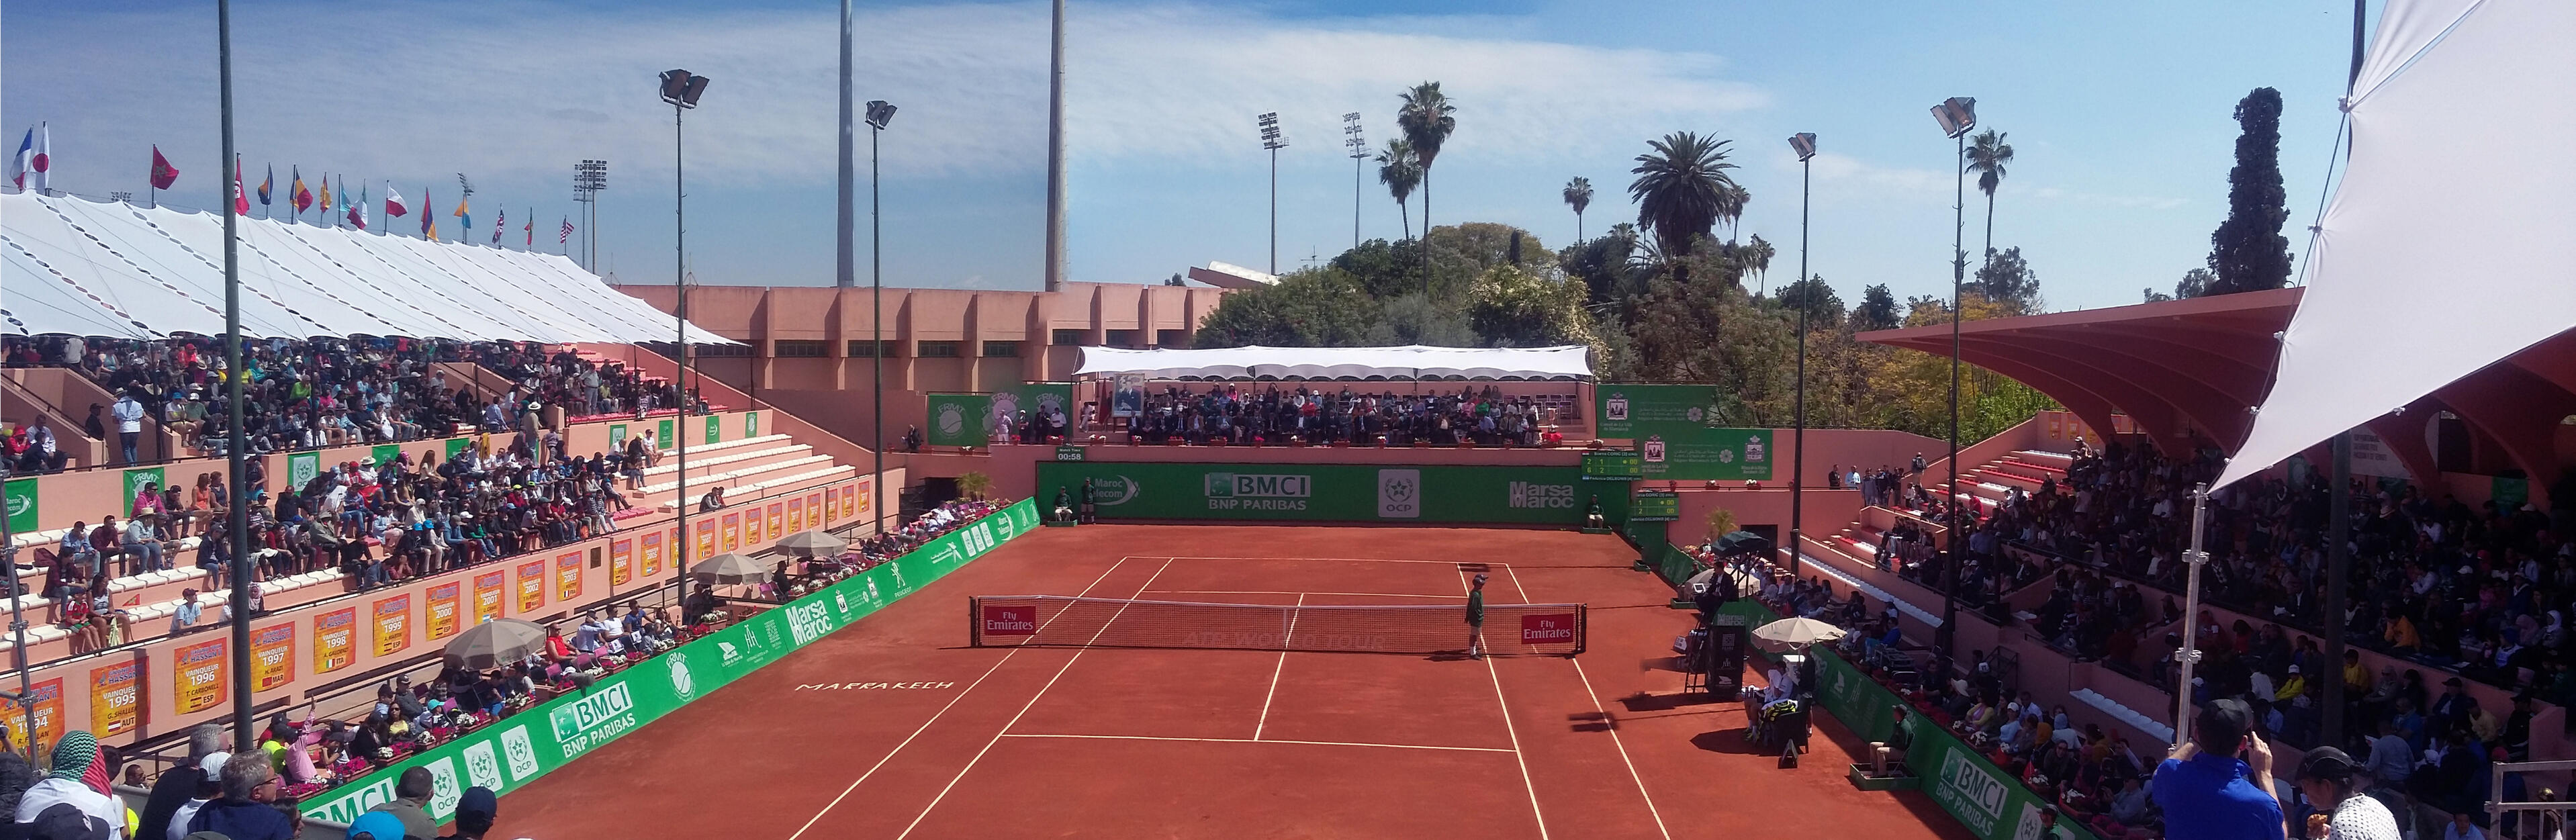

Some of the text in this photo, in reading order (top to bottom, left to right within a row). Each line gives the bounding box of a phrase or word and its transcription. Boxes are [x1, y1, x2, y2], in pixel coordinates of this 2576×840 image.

[991, 392, 1020, 403] FRMT
[1036, 393, 1065, 403] FRMT
[937, 403, 966, 414] FRMT
[133, 472, 160, 484] FRMT
[1095, 479, 1122, 487] Maroc
[1238, 477, 1306, 495] BMCI
[1510, 482, 1573, 496] Marsa
[1096, 489, 1122, 497] lecom
[1209, 500, 1306, 510] BNP PARIBAS
[1510, 494, 1574, 508] Maroc
[615, 559, 627, 568] 2004
[564, 573, 576, 583] 2003
[525, 584, 539, 594] 2002
[894, 586, 912, 598] PEUGEOT
[483, 596, 498, 605] 2001
[436, 608, 452, 618] 2000
[785, 599, 828, 627] Marsa
[1003, 612, 1016, 620] Fly
[384, 621, 402, 633] 1999
[790, 614, 833, 646] Maroc
[987, 620, 1033, 630] Emirates
[1540, 620, 1554, 628] Fly
[263, 635, 286, 644] HASSAN
[322, 629, 349, 641] VAINQUEUR
[1524, 628, 1571, 639] Emirates
[327, 637, 346, 649] 1998
[191, 652, 217, 663] HASSAN
[258, 645, 288, 658] VAINQUEUR
[263, 653, 284, 667] 1997
[666, 652, 687, 669] FRMT
[185, 663, 219, 678] VAINQUEUR
[270, 665, 283, 673] ARAZI
[109, 671, 138, 684] HASSAN
[191, 671, 215, 686] 1996
[273, 674, 283, 683] MAR
[103, 684, 140, 700] VAINQUEUR
[191, 684, 219, 696] CARBONELL
[794, 682, 954, 691] MARRAKECH
[109, 692, 136, 709] 1995
[203, 694, 214, 704] ESP
[114, 706, 138, 718] SHALLER
[580, 684, 630, 729] BMCI
[11, 707, 53, 723] VAINUEUR
[17, 716, 48, 734] 194
[122, 716, 135, 727] AUT
[25, 730, 49, 743] FLAN
[563, 713, 636, 759] BNP PARIBAS
[516, 761, 533, 774] OCP
[1958, 763, 2005, 813] BMCI
[438, 796, 457, 811] OCP
[1937, 782, 1994, 836] BNP PARIBAS
